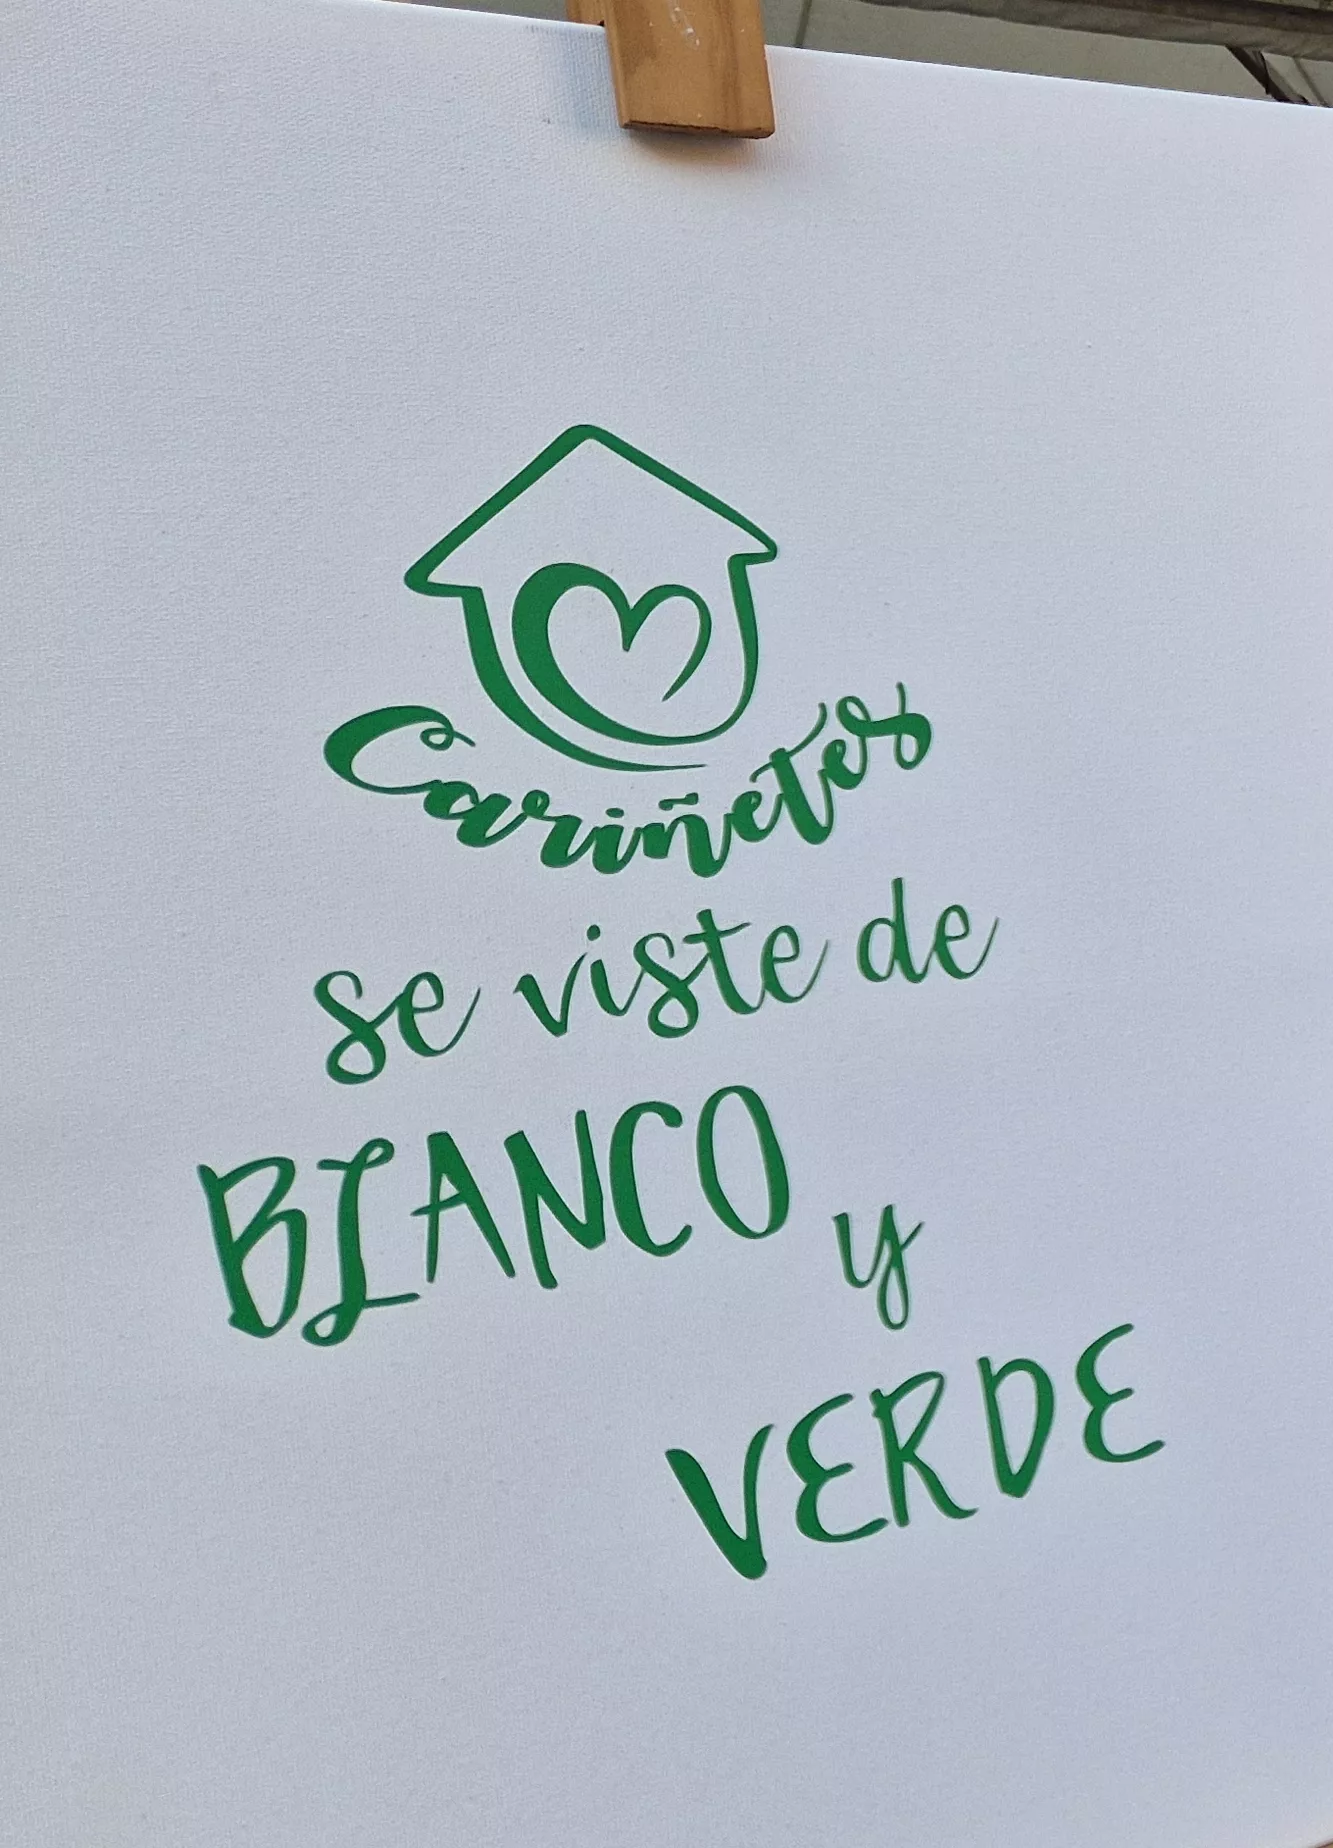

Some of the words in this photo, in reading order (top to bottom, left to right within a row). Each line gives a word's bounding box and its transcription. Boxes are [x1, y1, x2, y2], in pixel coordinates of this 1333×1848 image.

[323, 682, 932, 879] Cariñetes
[313, 967, 481, 1084] se
[513, 909, 828, 1038] viste
[857, 877, 1000, 984] de
[199, 1085, 790, 1347] BLANCO
[833, 1205, 924, 1331] y
[665, 1323, 1166, 1580] VERDE
